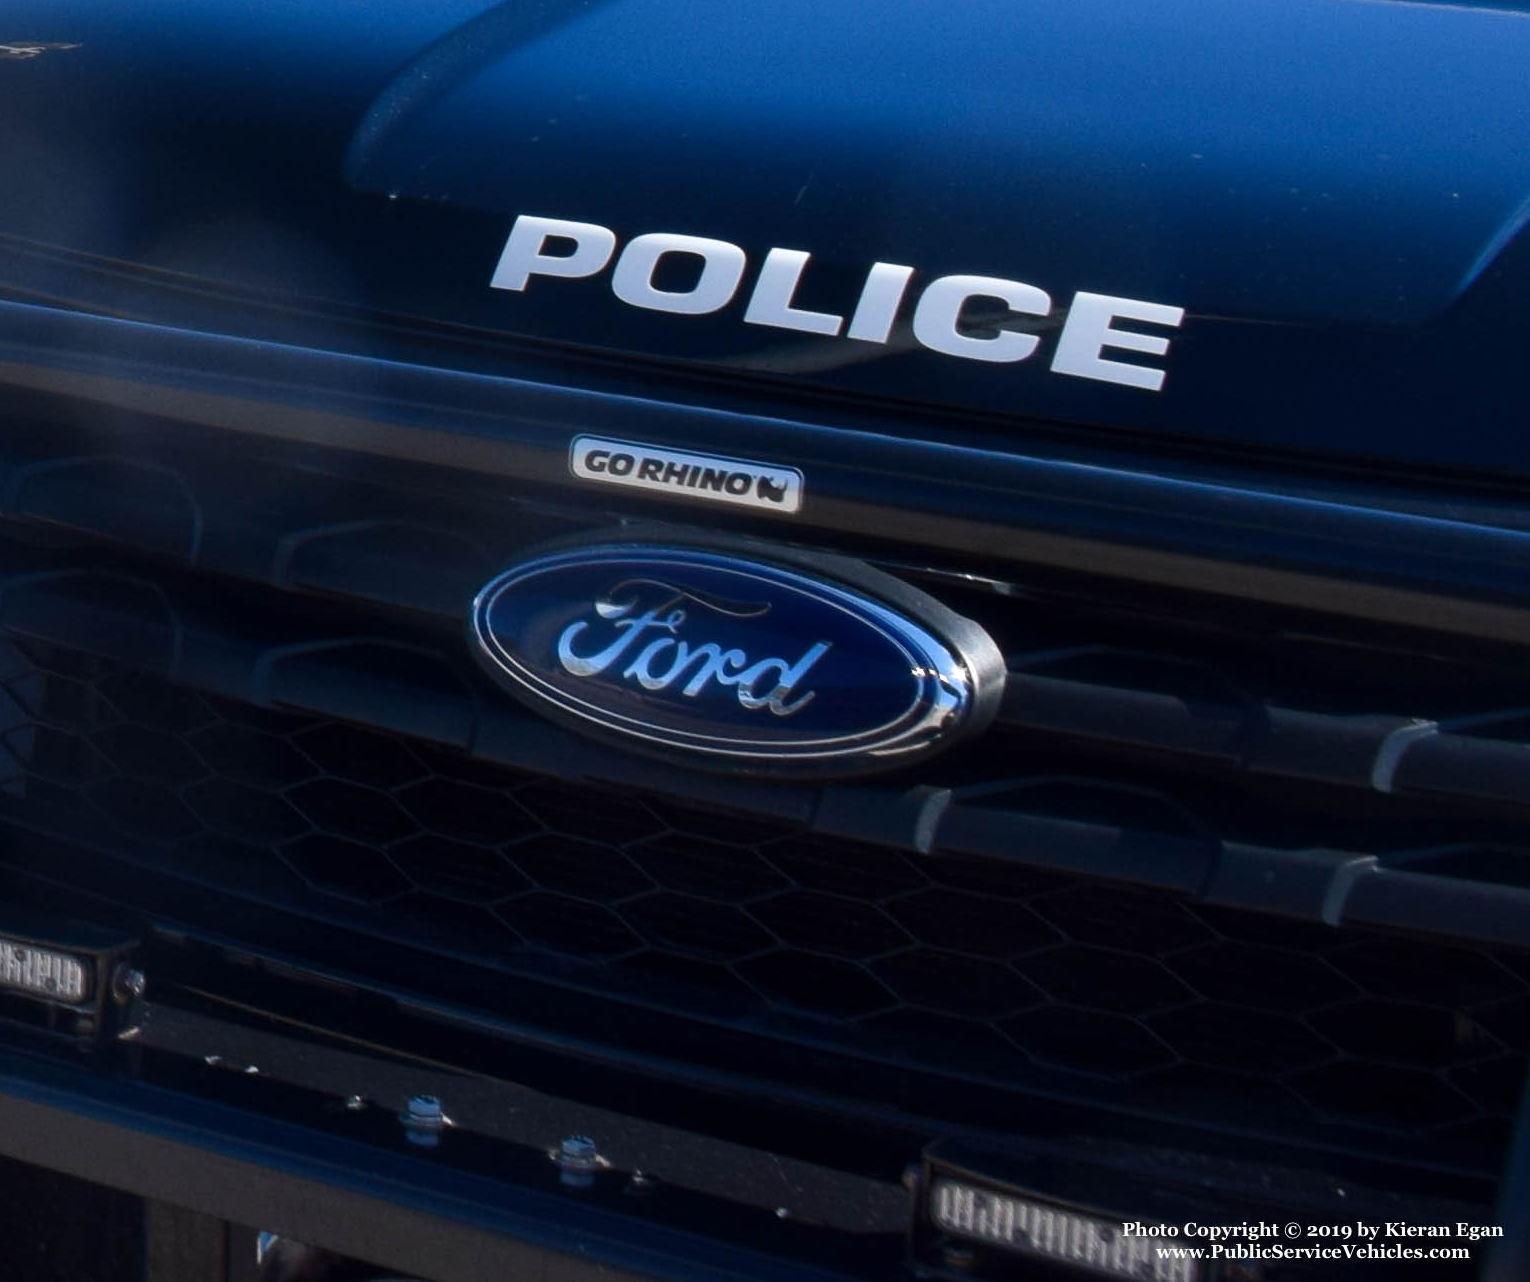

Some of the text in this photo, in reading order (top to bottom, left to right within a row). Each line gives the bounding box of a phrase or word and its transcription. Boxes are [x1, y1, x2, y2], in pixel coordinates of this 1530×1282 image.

[489, 215, 1185, 391] POLICE
[584, 449, 753, 496] GO RHINO
[558, 578, 833, 716] Ford
